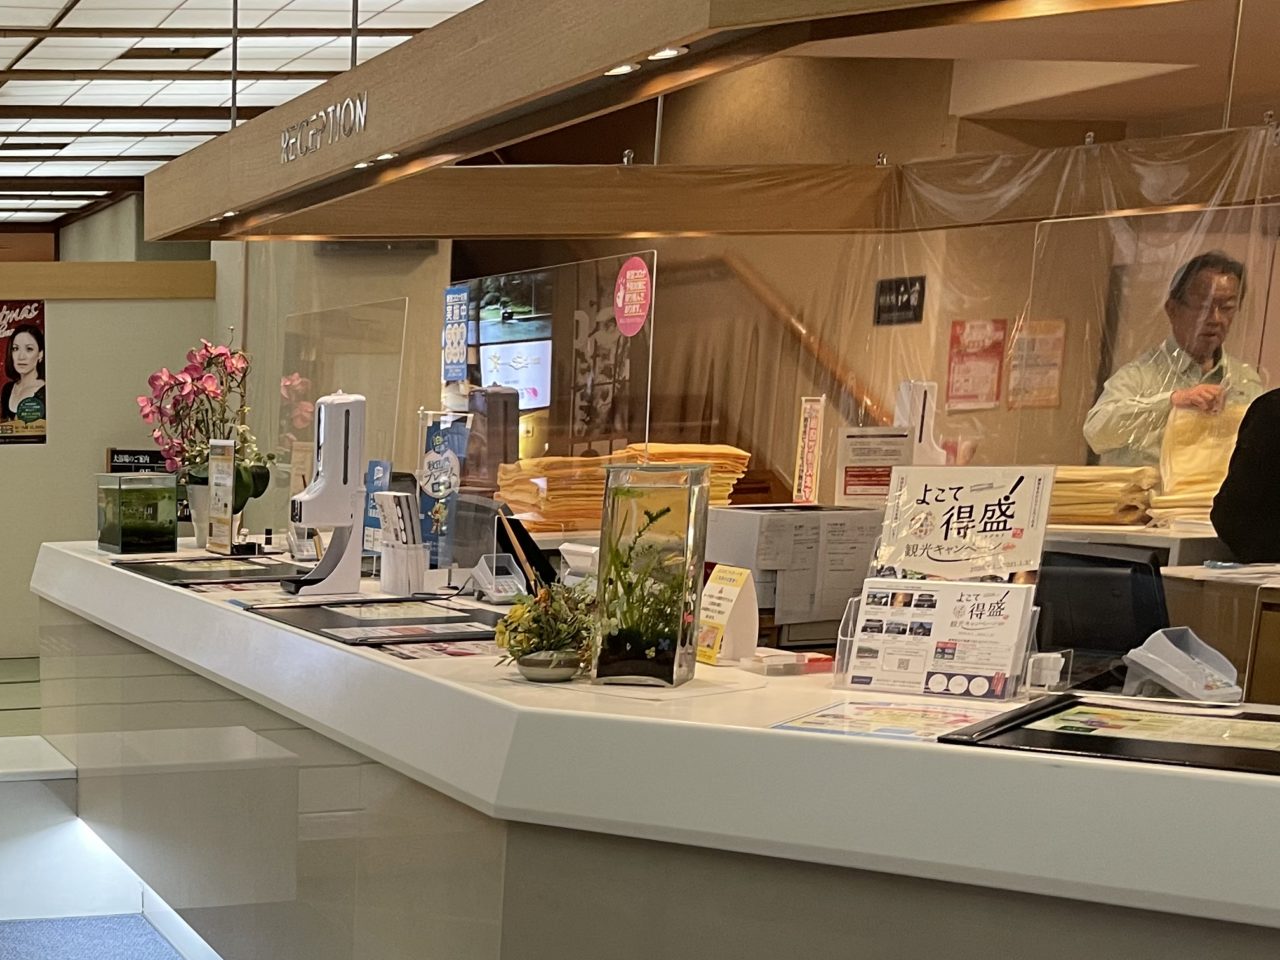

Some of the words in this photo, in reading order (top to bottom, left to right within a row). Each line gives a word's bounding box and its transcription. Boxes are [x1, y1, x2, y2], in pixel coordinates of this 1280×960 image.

[281, 90, 368, 164] RECEPTION
[916, 483, 964, 505] よこて
